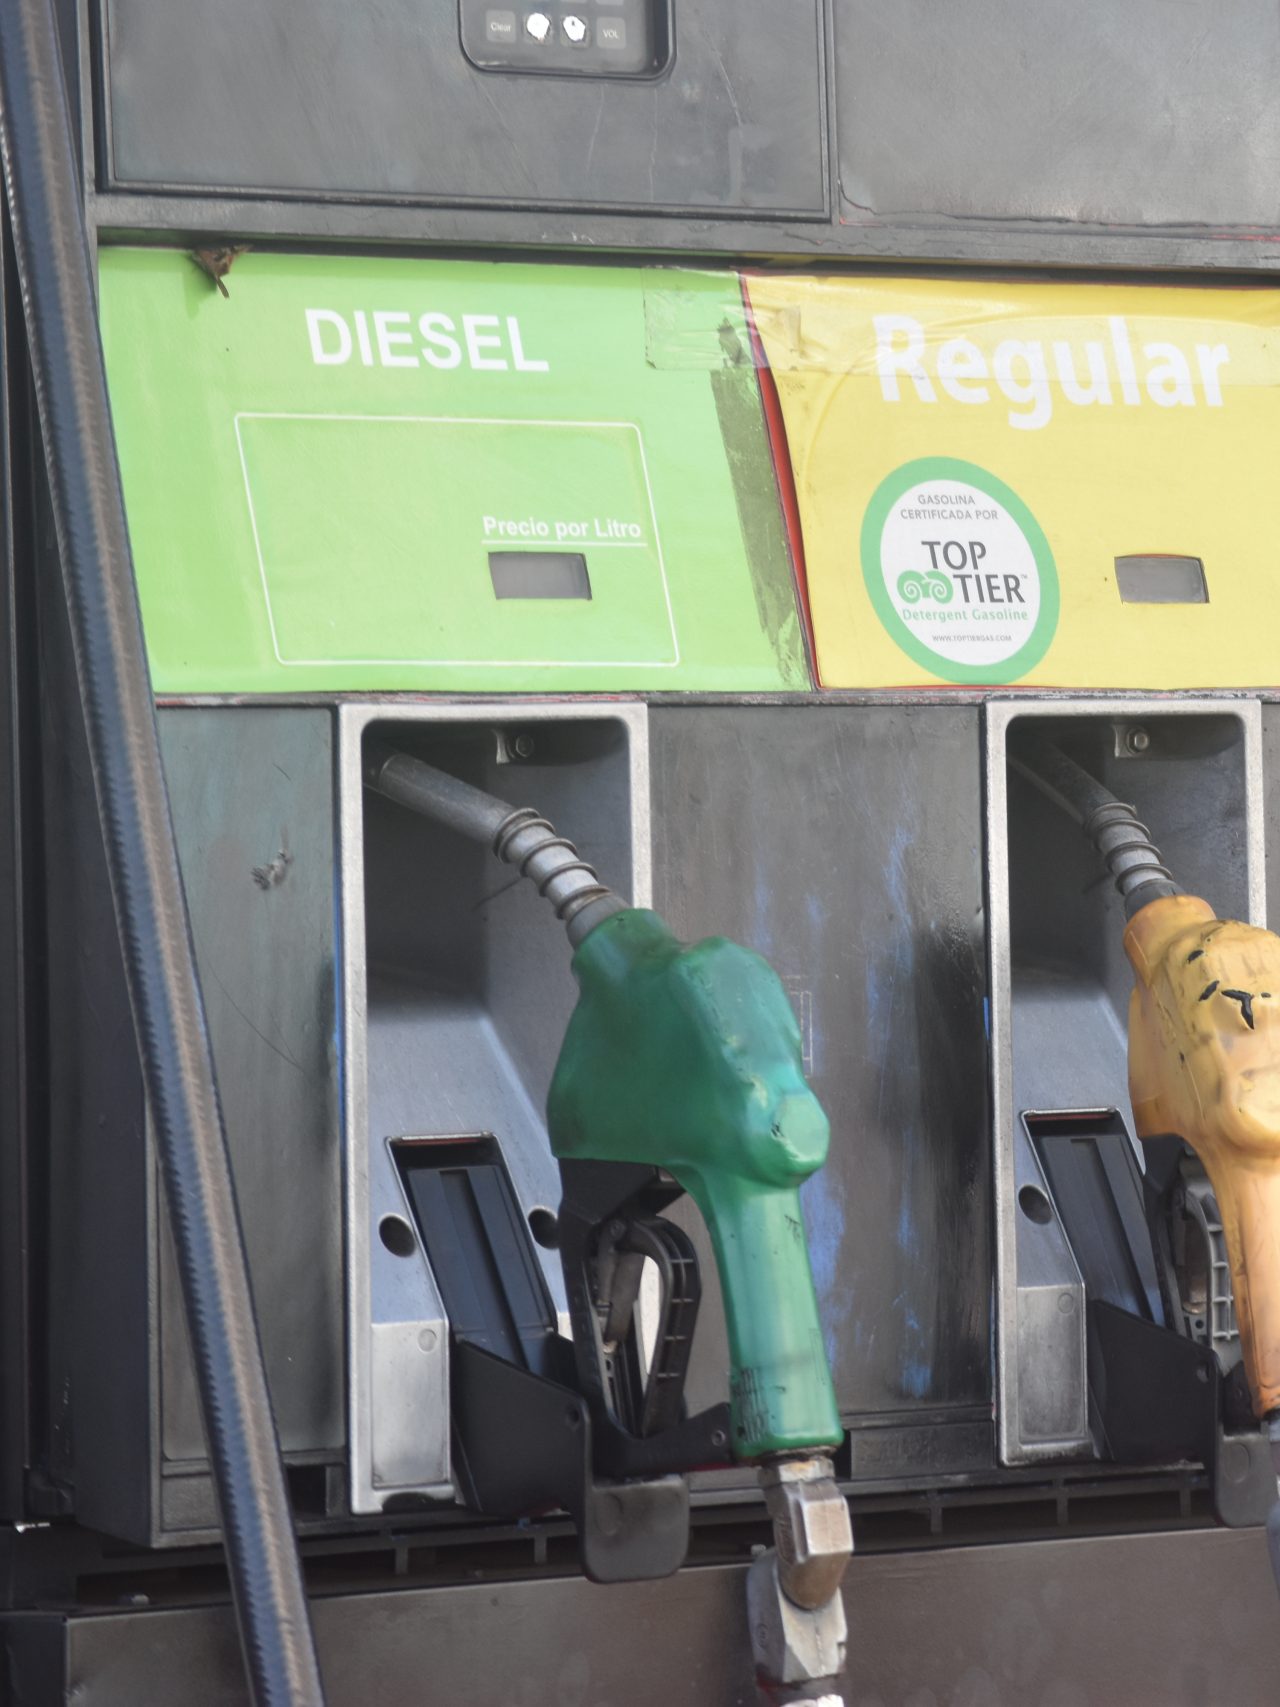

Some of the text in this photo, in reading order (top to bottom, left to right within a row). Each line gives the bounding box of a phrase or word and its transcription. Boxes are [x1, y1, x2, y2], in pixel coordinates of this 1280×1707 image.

[602, 29, 618, 39] VOL
[304, 308, 550, 372] DIESEL
[872, 314, 1230, 430] Regular
[918, 494, 976, 505] GASOLINA
[901, 509, 998, 520] CERTIFICADA POR
[482, 515, 642, 541] Precio por Litro
[921, 541, 986, 570] TOP
[902, 609, 1028, 623] Detergent Gasoline
